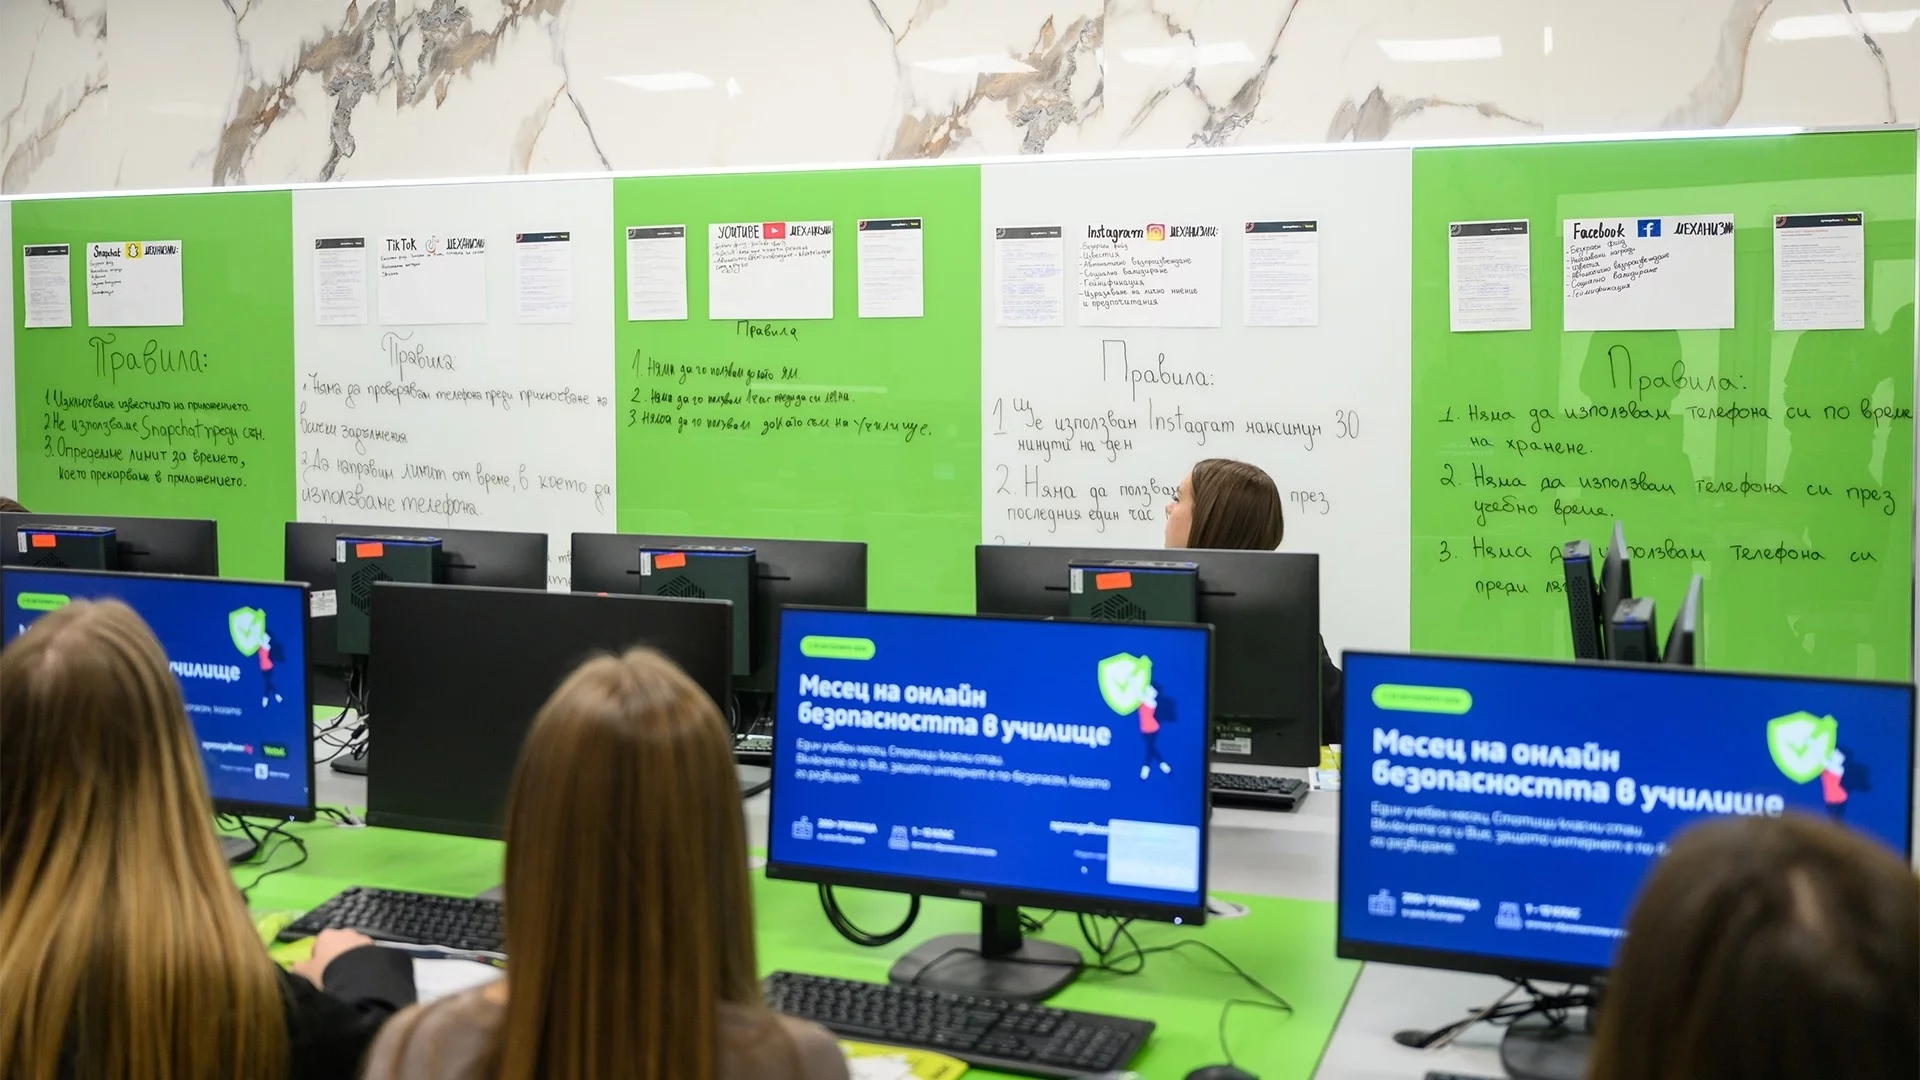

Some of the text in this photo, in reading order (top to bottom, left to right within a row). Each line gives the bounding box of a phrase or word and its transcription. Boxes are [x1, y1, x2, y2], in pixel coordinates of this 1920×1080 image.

[718, 225, 760, 239] YOUTUBE
[1088, 224, 1144, 243] Instagram
[1573, 222, 1626, 240] Facebook
[94, 244, 121, 259] Snapchat
[736, 320, 799, 341] Правила
[88, 333, 208, 385] Правила:
[1102, 340, 1215, 402] Правила:
[1608, 344, 1749, 402] Правила:
[678, 364, 693, 385] да
[696, 365, 707, 375] го
[710, 362, 744, 379] ползвам
[174, 402, 185, 410] на
[345, 383, 361, 409] да
[436, 388, 482, 406] телефона
[485, 390, 513, 411] преди
[597, 396, 608, 407] на
[676, 394, 690, 411] да
[53, 412, 66, 431] Не
[72, 417, 139, 437] използваме
[140, 414, 203, 446] Snapchat
[204, 425, 239, 446] преди
[678, 416, 688, 434] да
[706, 417, 751, 431] ползвам
[835, 416, 849, 428] на
[1012, 398, 1044, 431] Ще
[1149, 397, 1235, 446] Instagram
[1336, 409, 1360, 439] 30
[1438, 406, 1460, 423] 1.
[1468, 404, 1517, 422] Няма
[1529, 408, 1555, 434] да
[1564, 400, 1671, 421] използвам
[1686, 402, 1773, 428] телефона
[1786, 405, 1811, 419] си
[1824, 406, 1850, 421] по
[172, 450, 187, 469] за
[192, 452, 246, 469] времето,
[1080, 440, 1096, 452] на
[1106, 439, 1133, 463] ден
[1470, 436, 1593, 458] на хранене.
[58, 466, 87, 481] което
[155, 470, 162, 484] в
[337, 458, 395, 482] направим
[452, 470, 471, 483] от
[518, 463, 529, 491] в
[538, 474, 587, 493] което
[594, 484, 612, 516] да
[1440, 462, 1896, 516] 2. Няма да използвам телефона си през
[996, 464, 1017, 495] 2.
[1090, 486, 1109, 514] да
[1290, 488, 1330, 516] през
[1008, 508, 1155, 534] последния един час
[1474, 494, 1614, 527] учебно време.
[1439, 536, 1879, 565] 3. Няма телефона си
[1475, 580, 1529, 600] преди
[799, 673, 988, 709] Месец на онлайн
[797, 701, 1112, 749] безопасността в училище
[1372, 727, 1620, 772] Месец на онлайн
[1372, 758, 1610, 804] безопасността
[1615, 777, 1636, 806] в
